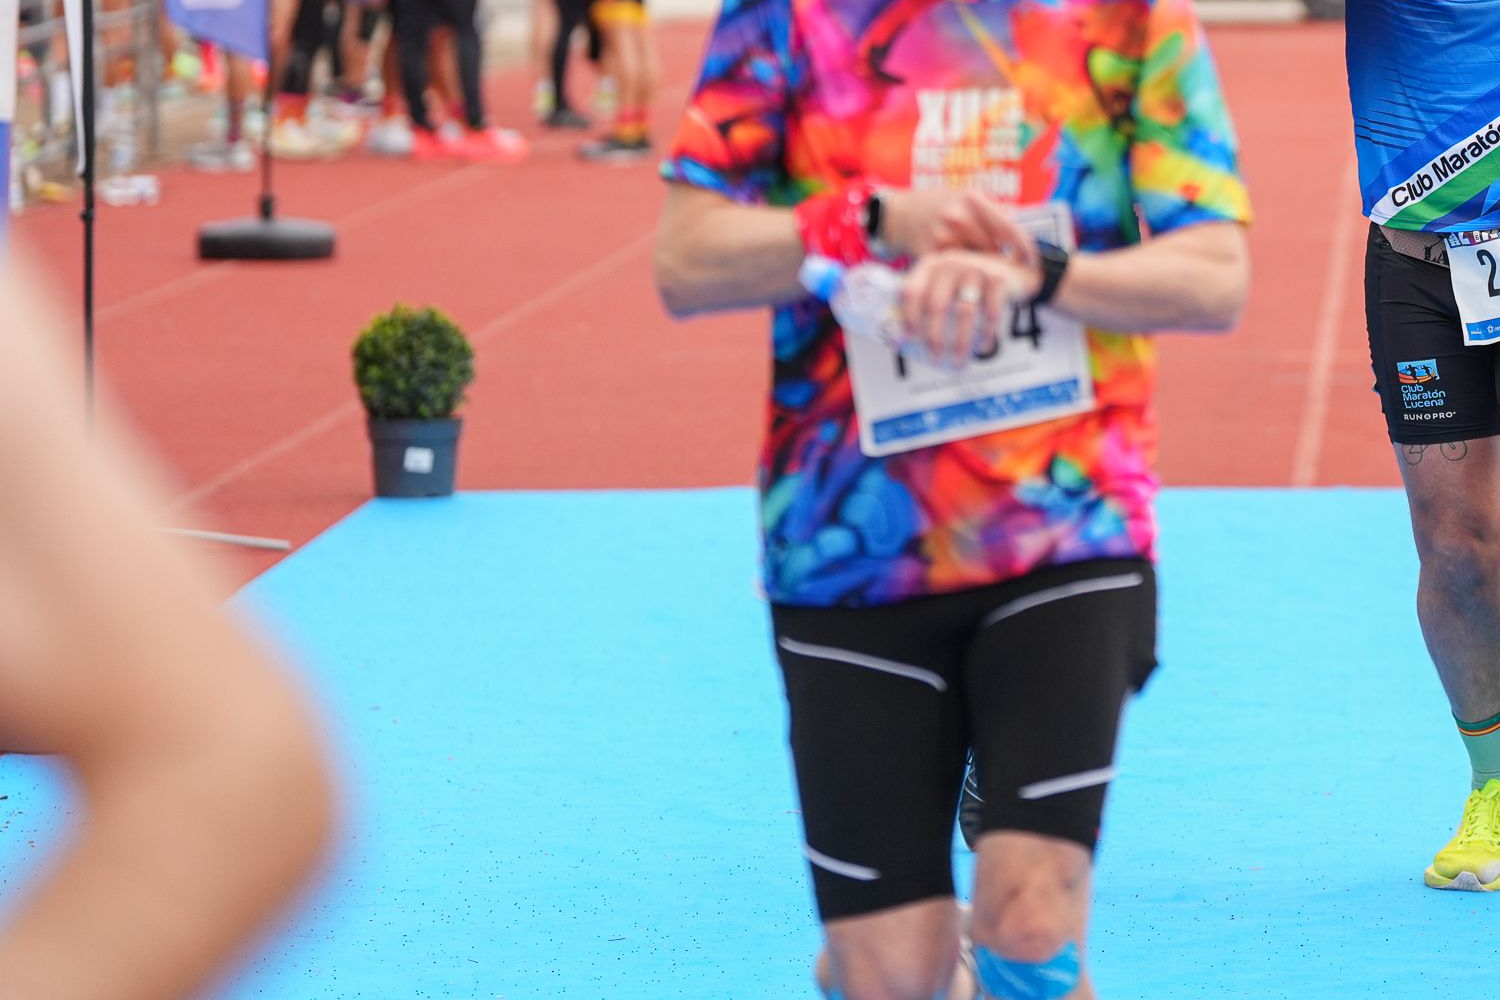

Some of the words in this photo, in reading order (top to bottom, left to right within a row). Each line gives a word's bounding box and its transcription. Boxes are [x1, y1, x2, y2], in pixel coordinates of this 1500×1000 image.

[1391, 173, 1434, 208] Club
[1401, 384, 1424, 393] Club
[1402, 389, 1446, 401] Maratón
[1404, 398, 1444, 409] Lucena
